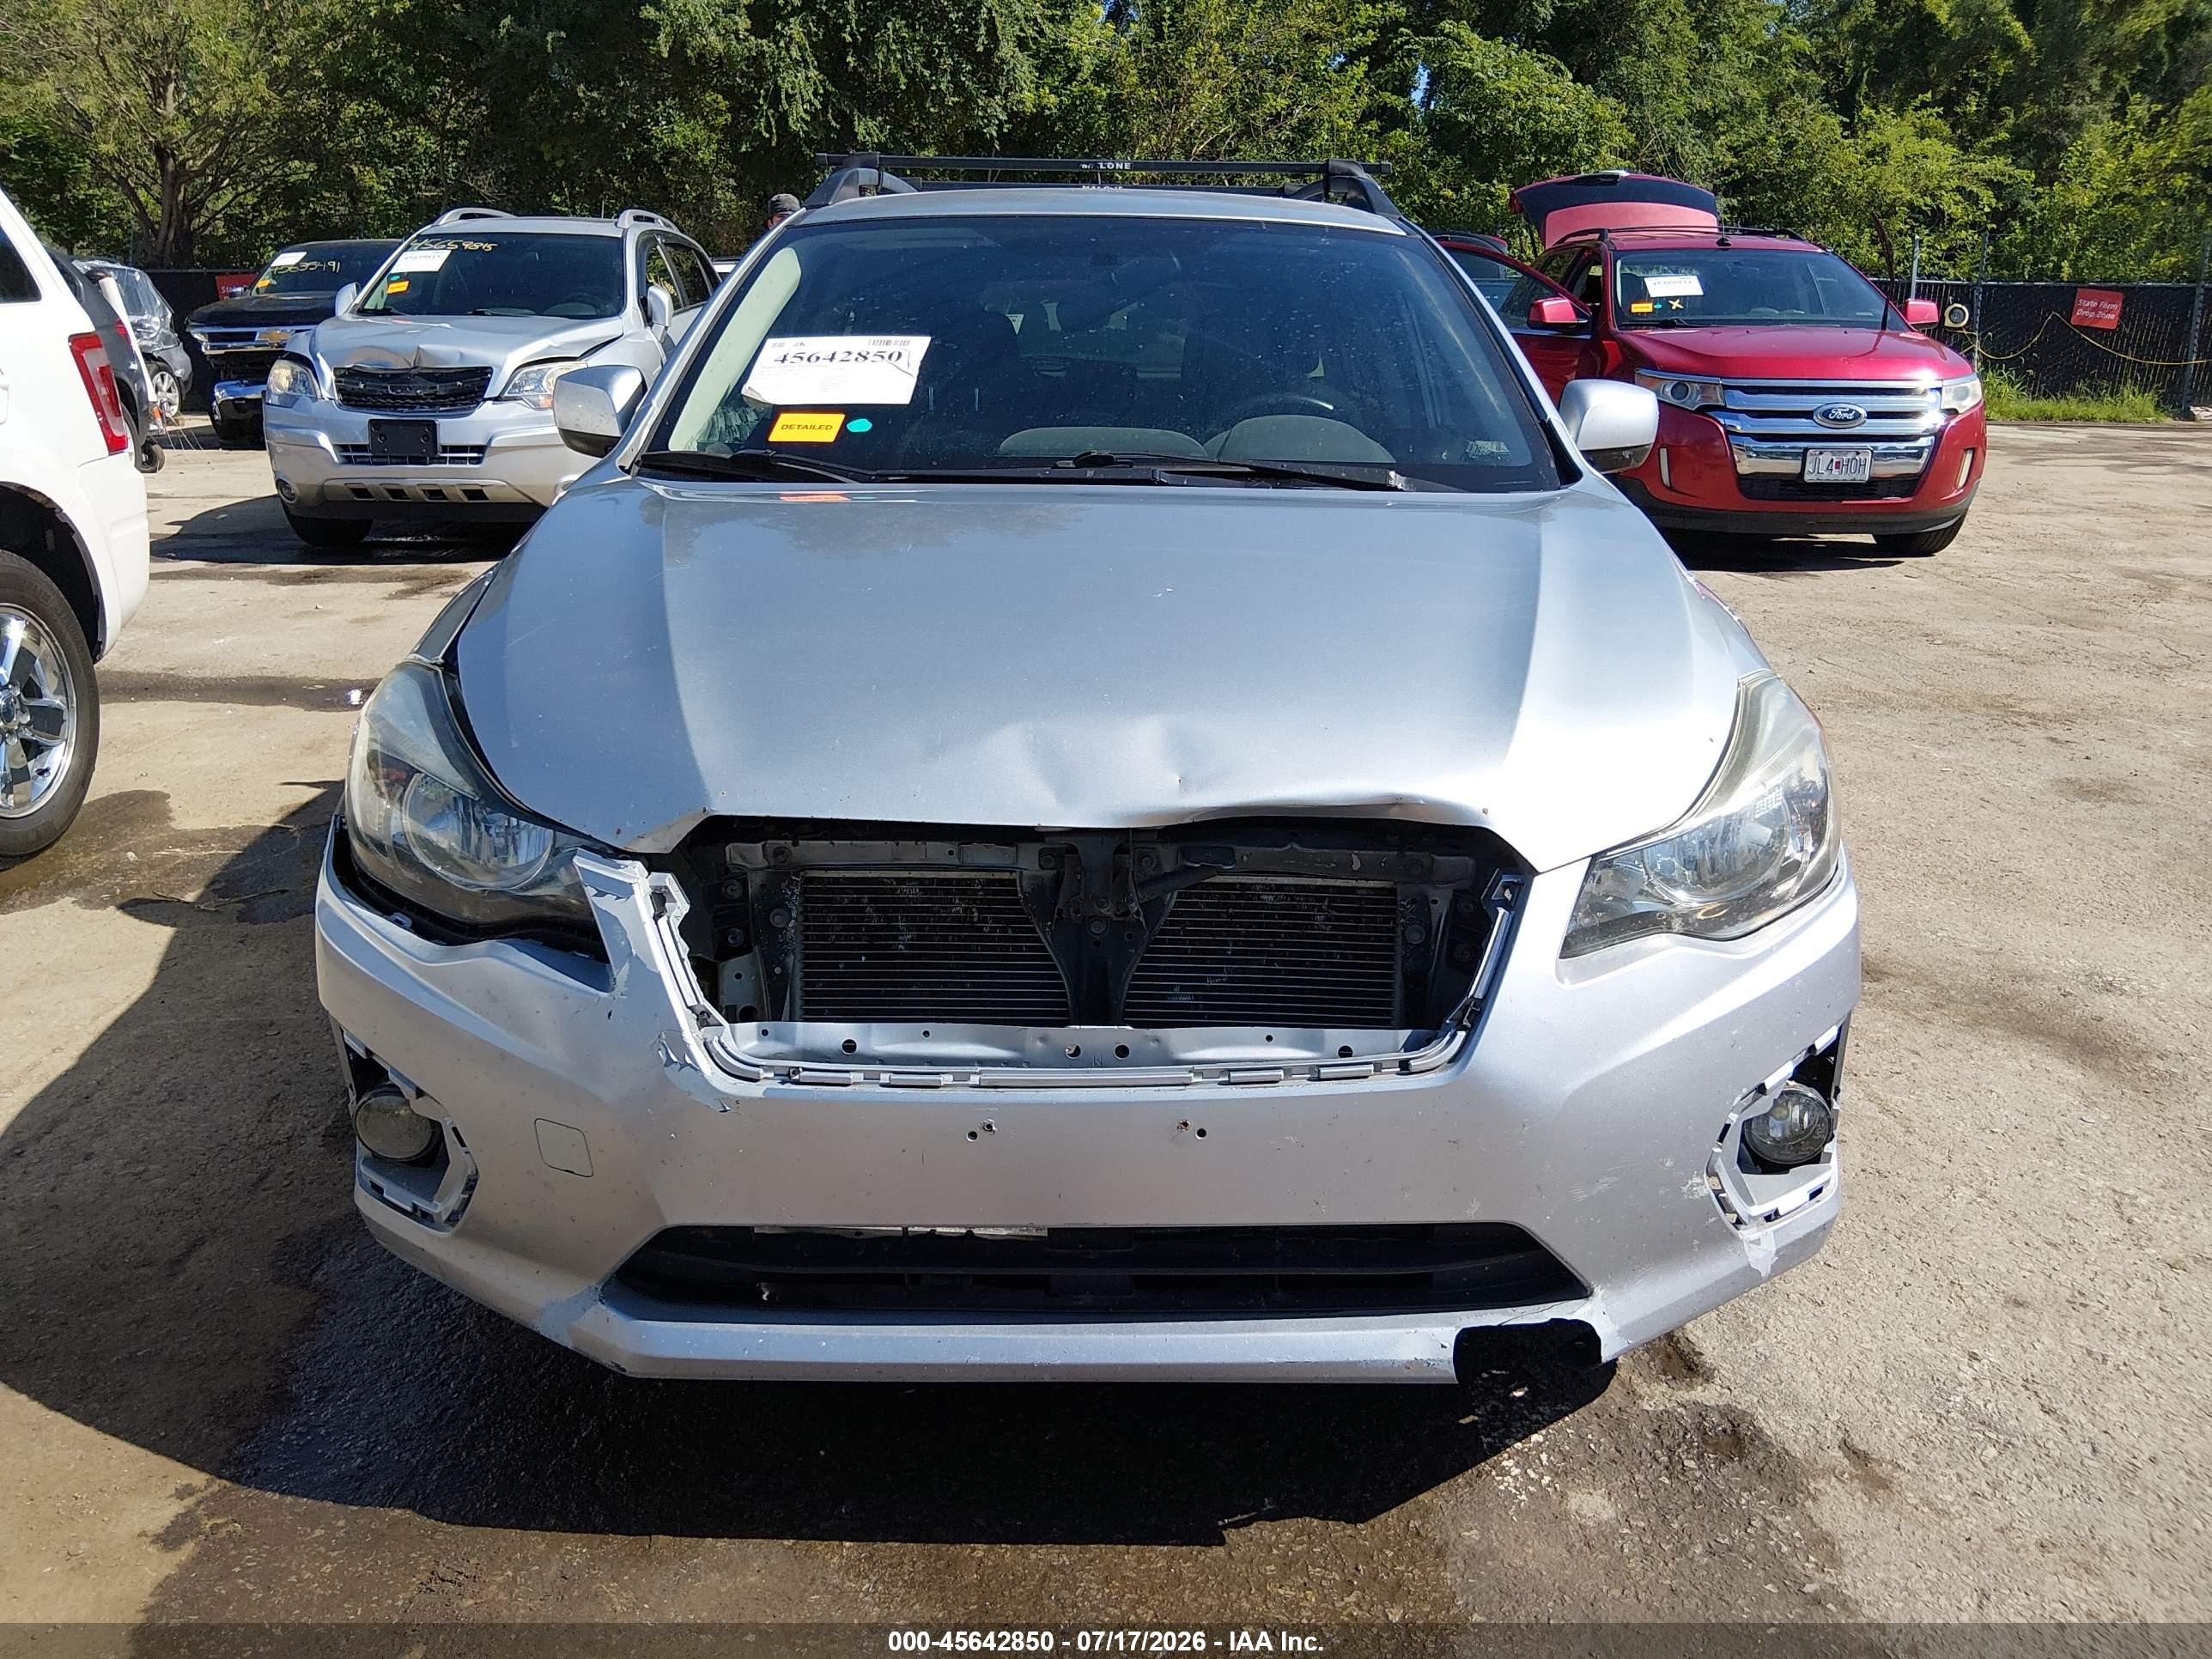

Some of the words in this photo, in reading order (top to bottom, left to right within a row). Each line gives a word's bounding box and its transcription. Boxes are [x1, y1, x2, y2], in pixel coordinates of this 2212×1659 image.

[2078, 298, 2098, 307] State
[2100, 301, 2118, 310] Farm
[2075, 308, 2096, 319] Drop
[2096, 311, 2116, 320] Zone
[774, 349, 903, 364] 45642850
[1828, 407, 1855, 420] Ford
